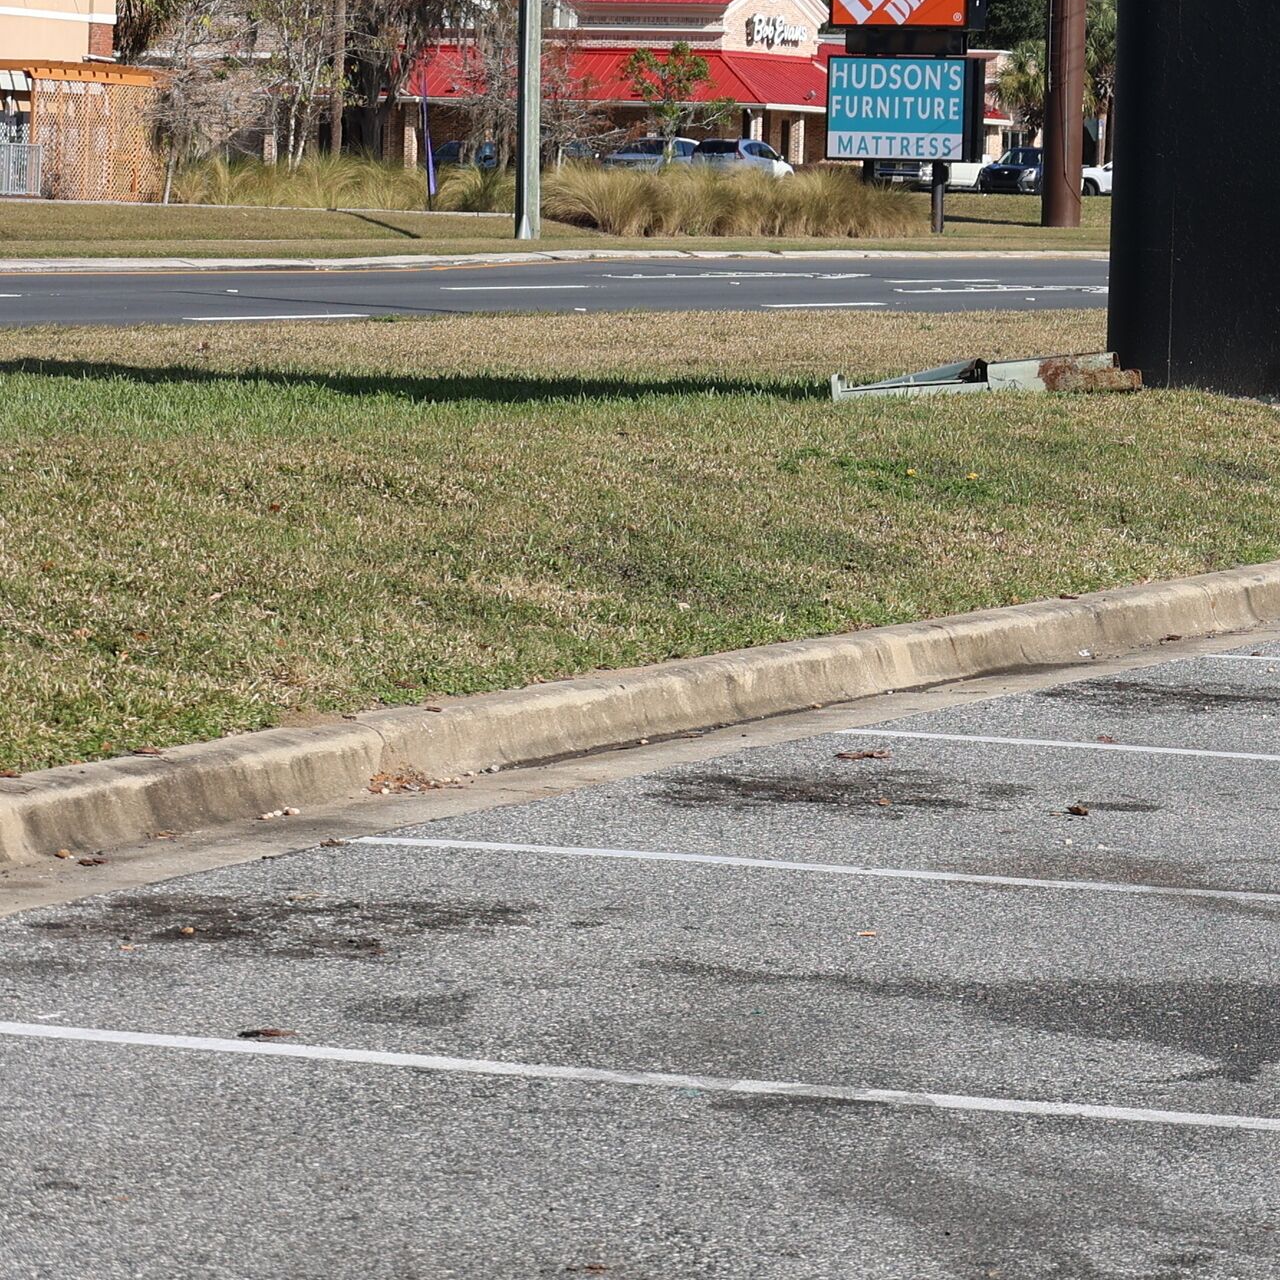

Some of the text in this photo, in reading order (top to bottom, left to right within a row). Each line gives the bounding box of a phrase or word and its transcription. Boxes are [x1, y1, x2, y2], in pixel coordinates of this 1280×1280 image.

[753, 13, 807, 44] Bob Evans
[832, 62, 961, 90] HUDSON'S
[832, 95, 960, 120] FURNITURE
[837, 135, 952, 156] MATTRESS
